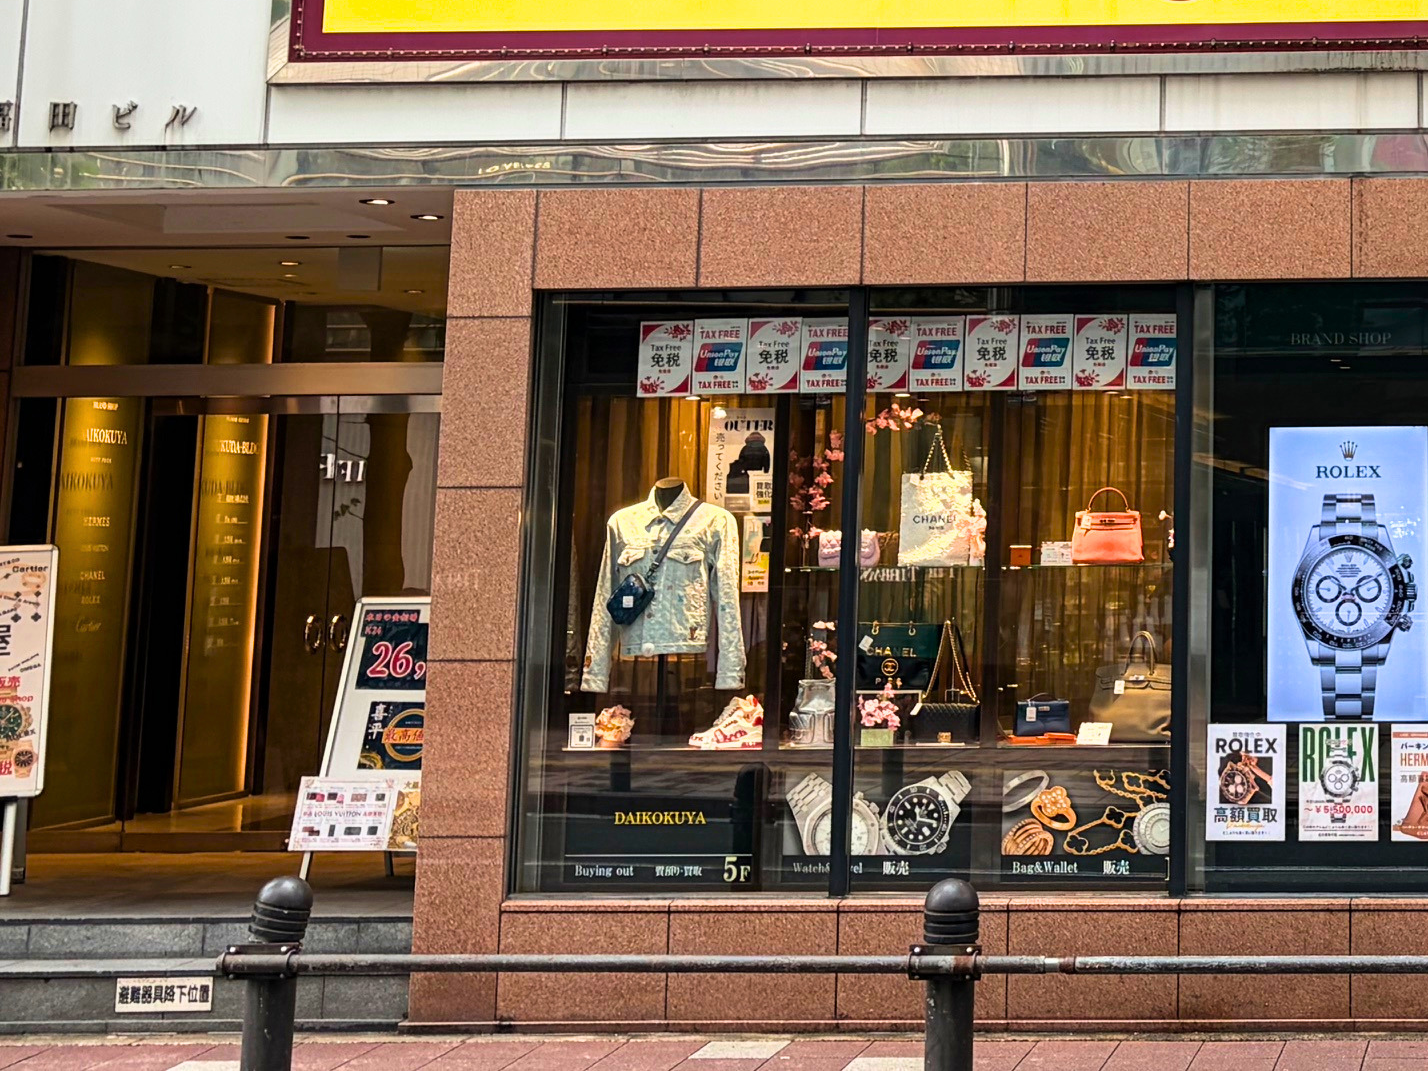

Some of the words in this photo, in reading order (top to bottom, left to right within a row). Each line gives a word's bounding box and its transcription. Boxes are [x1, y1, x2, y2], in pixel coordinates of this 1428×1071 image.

[700, 330, 715, 339] TAX
[717, 329, 740, 339] FREE
[808, 329, 825, 338] TAX
[826, 329, 848, 337] FREE
[916, 327, 936, 337] TAX
[938, 327, 958, 336] FREE
[1026, 325, 1044, 335] TAX
[1046, 325, 1066, 334] FREE
[1134, 325, 1152, 334] TAX
[1154, 325, 1174, 333] FREE
[1291, 333, 1344, 345] BRAND
[1350, 332, 1392, 345] SHOP
[650, 353, 681, 367] 免税
[758, 349, 789, 364] 免税
[869, 348, 898, 363] 免税
[976, 346, 1007, 361] 免税
[1086, 345, 1115, 361] 免税
[698, 381, 712, 389] TAX
[714, 381, 731, 389] FREE
[916, 378, 932, 386] TAX
[933, 377, 949, 385] FREE
[84, 428, 128, 445] AIKOKUYA
[1316, 466, 1381, 479] ROLEX
[1215, 738, 1277, 753] ROLEX
[615, 811, 706, 825] DAIKOKUYA
[1214, 806, 1277, 823] 高額買取
[575, 865, 613, 878] Buying
[616, 865, 634, 876] out
[723, 856, 751, 882] 5F
[883, 861, 909, 876] 販売
[1012, 862, 1079, 874] Bag&Wallet
[1102, 861, 1130, 875] 販売
[118, 984, 210, 1004] 避難器具降下位置
